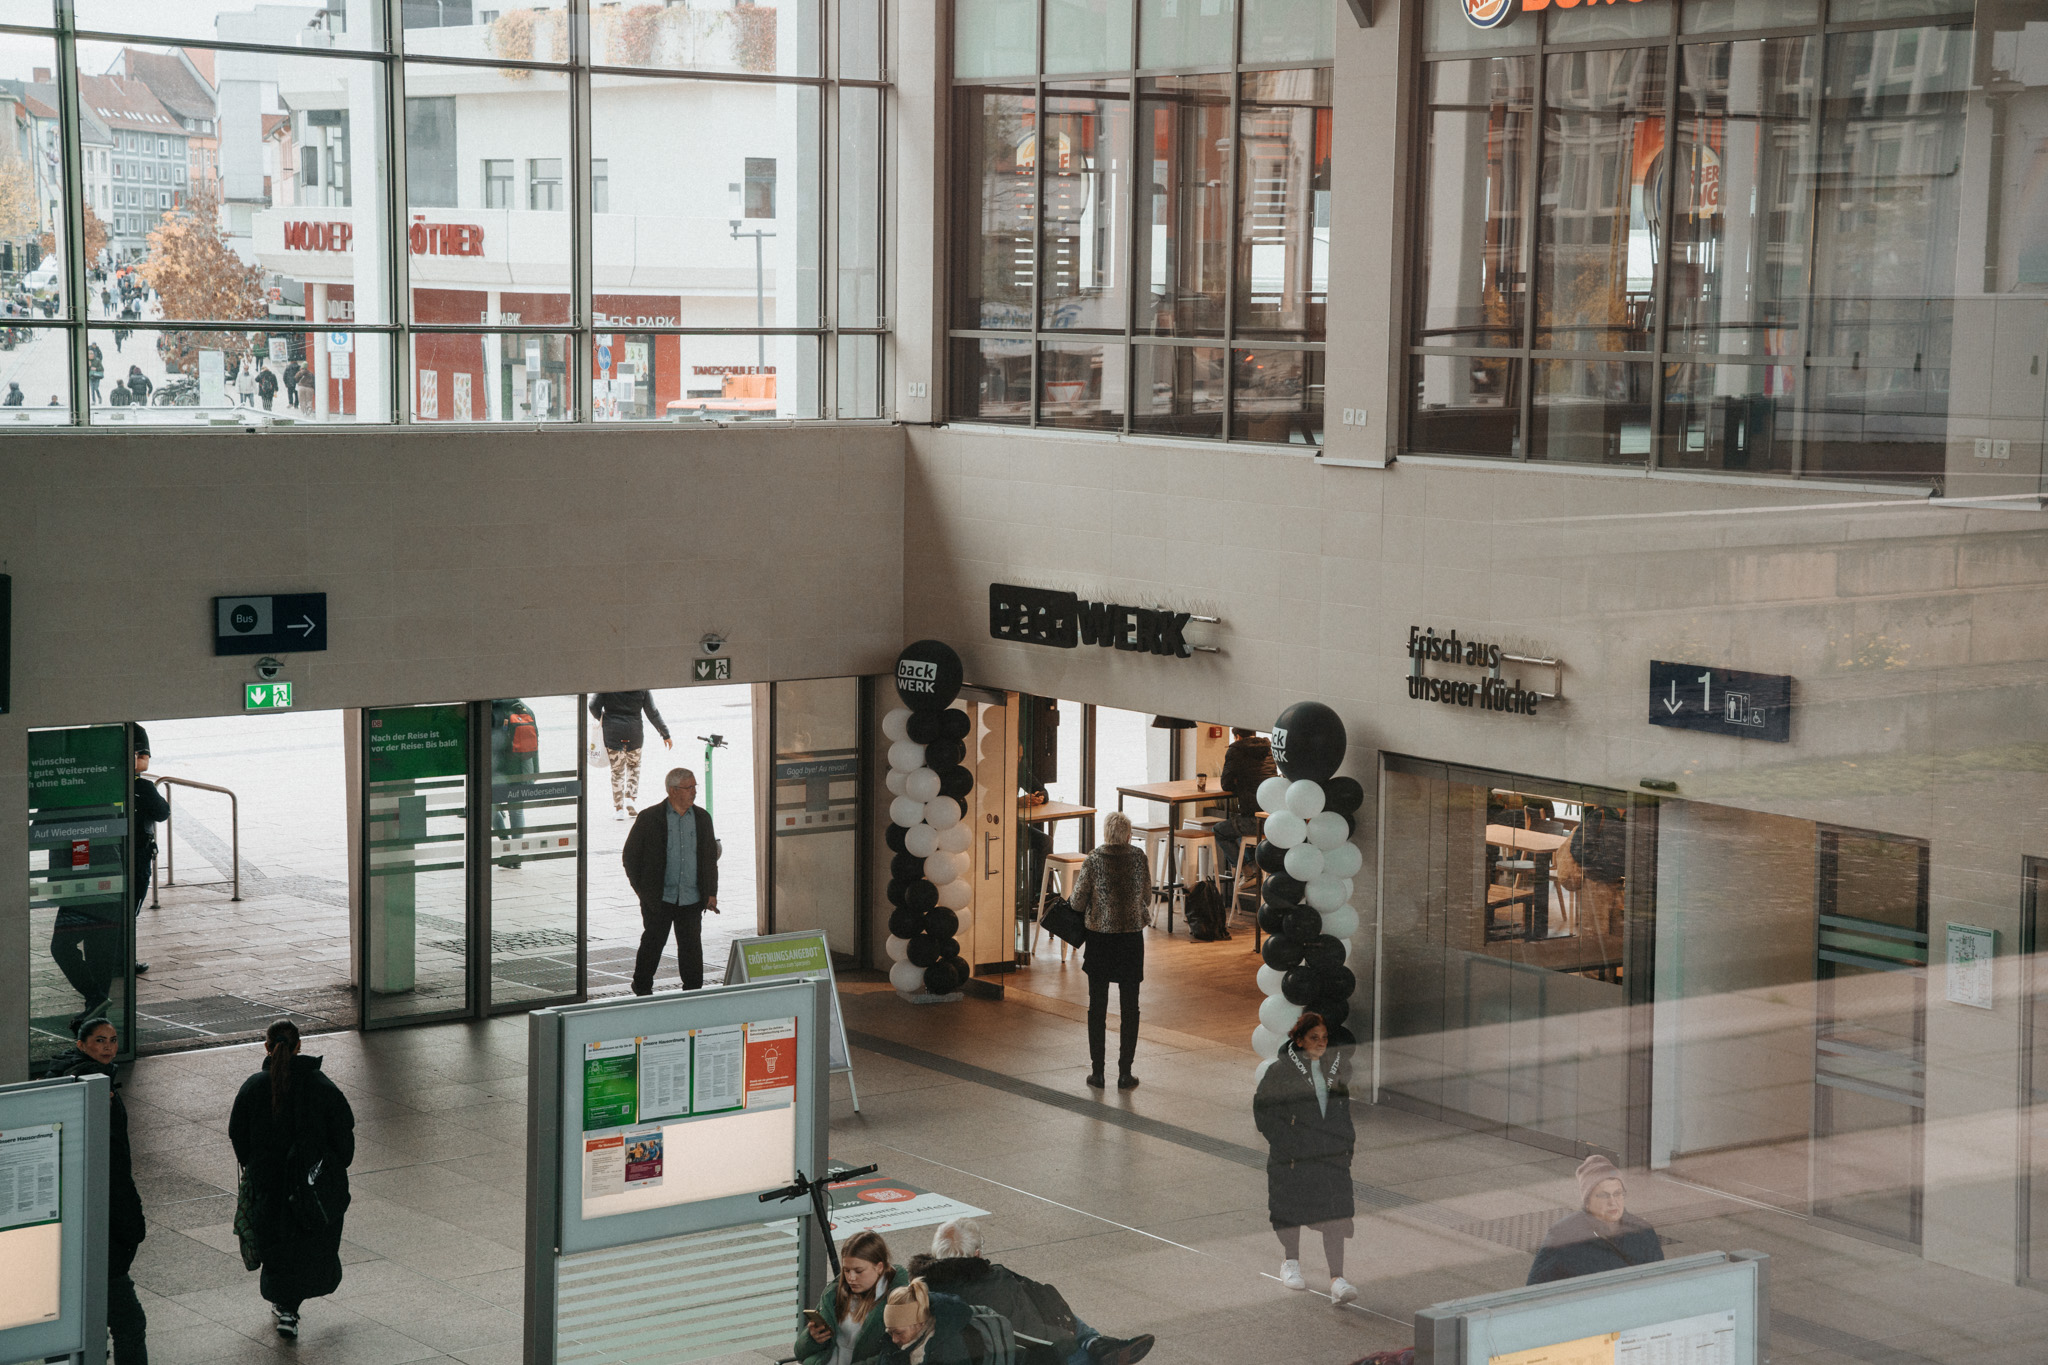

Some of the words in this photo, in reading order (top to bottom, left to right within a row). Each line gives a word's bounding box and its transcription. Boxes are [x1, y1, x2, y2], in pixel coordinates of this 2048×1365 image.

[284, 221, 353, 252] MODEP
[409, 215, 485, 257] ÖTHER
[501, 312, 521, 326] ARK
[636, 316, 675, 327] PARK
[236, 614, 253, 623] Bus
[1409, 625, 1462, 664] Frisch
[1466, 641, 1500, 669] aus
[900, 661, 934, 679] back
[898, 678, 935, 693] WERK
[1698, 671, 1711, 712] 1
[1408, 675, 1478, 707] unserer
[1480, 676, 1538, 715] Küche
[371, 734, 390, 742] Nach
[393, 733, 406, 741] der
[408, 731, 428, 740] Reise
[430, 730, 439, 738] ist
[1272, 730, 1285, 747] ck
[386, 743, 399, 751] der
[401, 742, 424, 750] Reise:
[425, 740, 437, 749] Bis
[439, 739, 458, 747] bald!
[32, 757, 76, 766] wünschen
[34, 769, 54, 779] gute
[56, 765, 108, 775] Weiterreise
[786, 767, 803, 775] Good
[804, 766, 818, 775] bye!
[828, 763, 848, 772] revoir!
[36, 779, 59, 788] ohne
[61, 777, 86, 786] Bahn.
[508, 790, 519, 798] Auf
[521, 786, 567, 797] Wiedersehen!
[34, 829, 49, 839] Auf
[51, 825, 108, 837] Wiedersehen!
[17, 1132, 54, 1142] Hausordnung
[834, 1207, 897, 1220] Finanzamt
